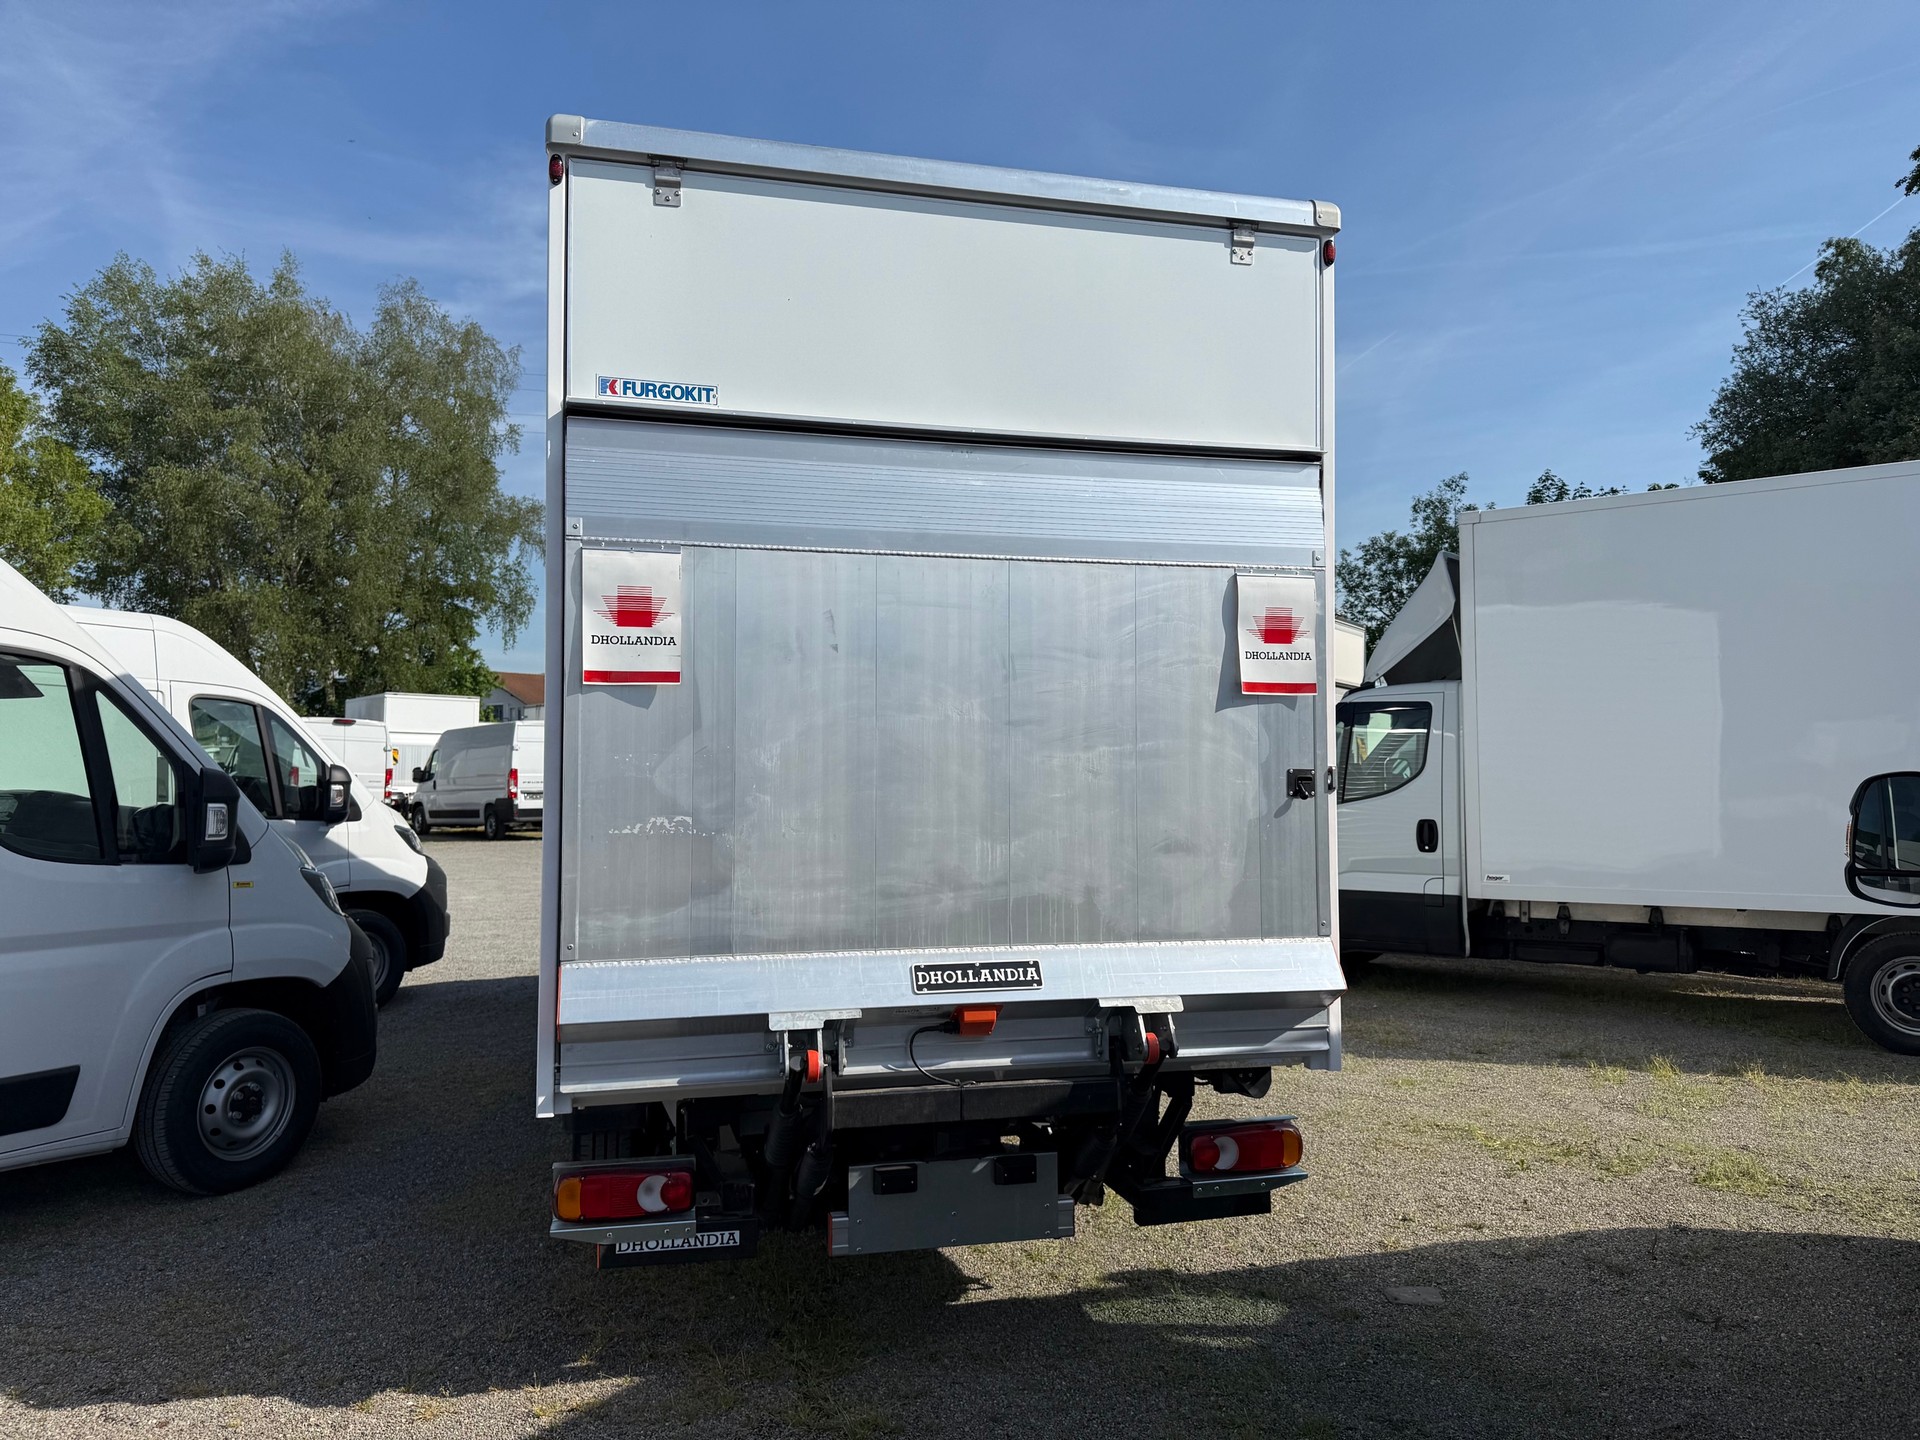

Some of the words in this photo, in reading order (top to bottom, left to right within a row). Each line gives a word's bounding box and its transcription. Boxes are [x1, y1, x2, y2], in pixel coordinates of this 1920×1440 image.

[622, 380, 715, 402] FURGOKIT
[590, 634, 677, 646] DHOLLANDIA
[1245, 651, 1312, 661] DHOLLANDIA
[916, 967, 1040, 985] DHOLLANDIA
